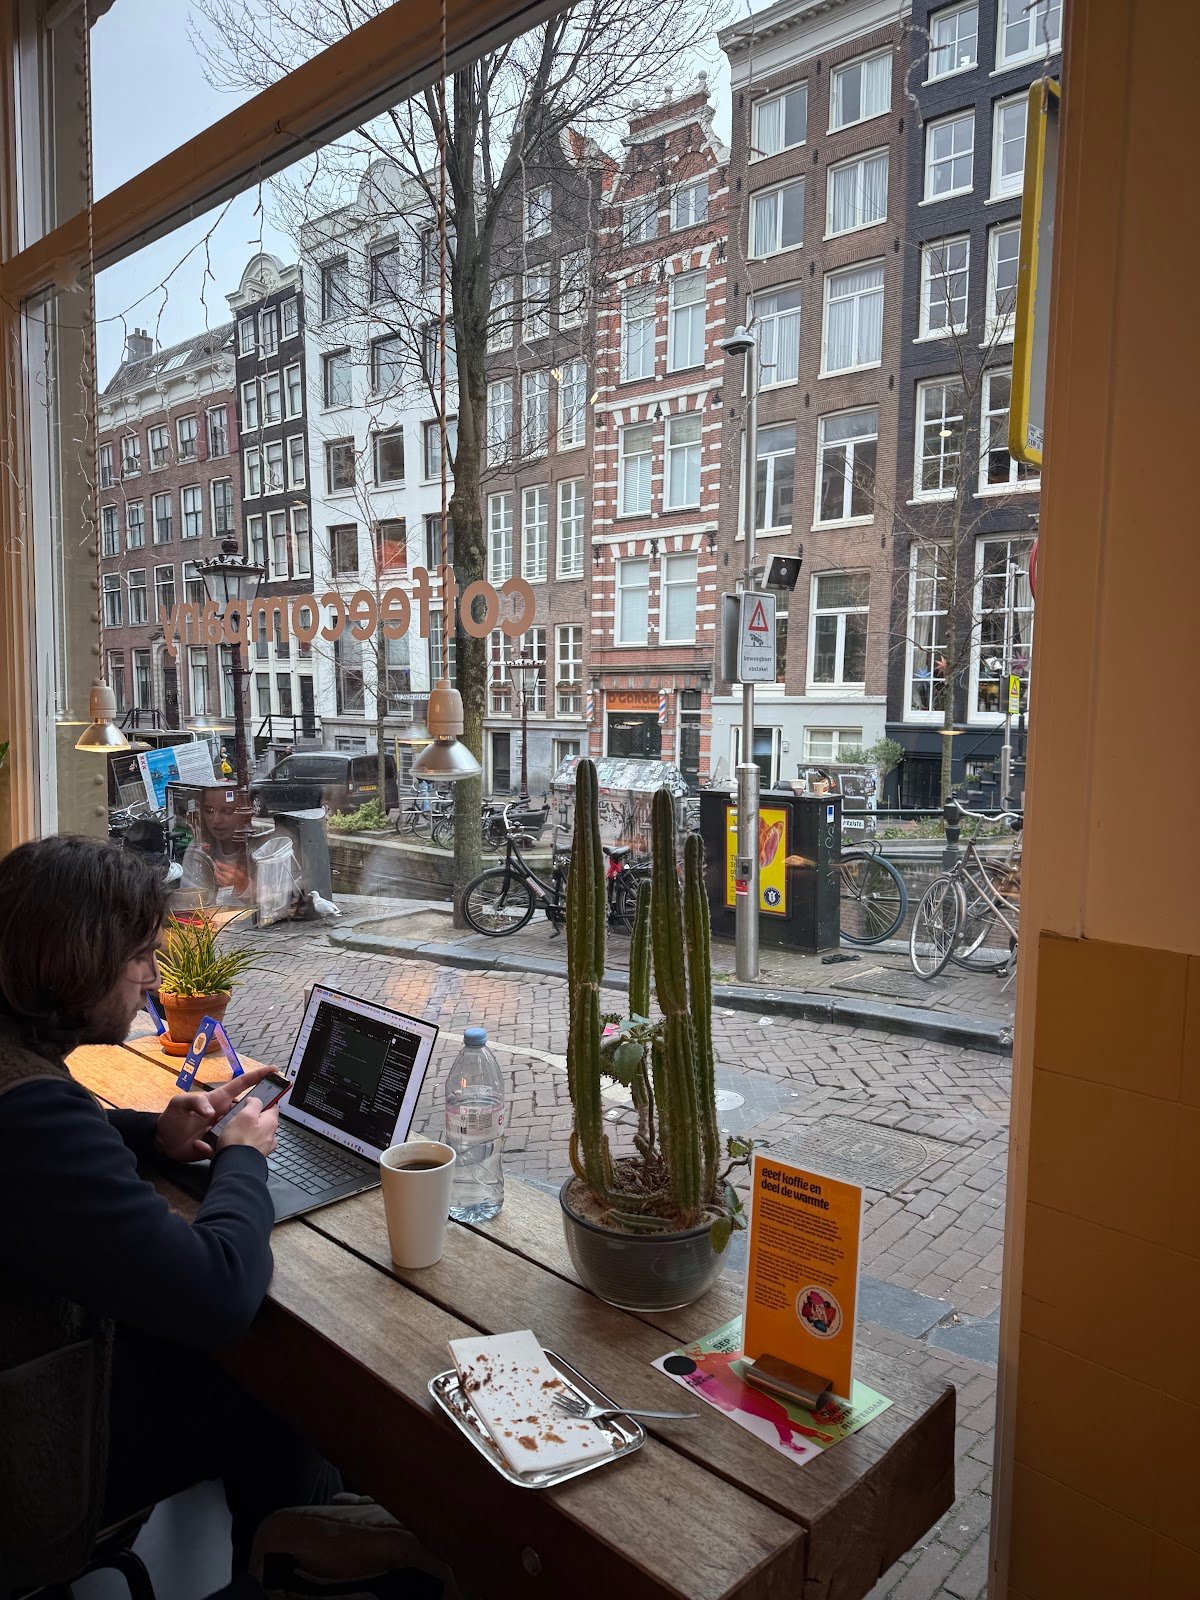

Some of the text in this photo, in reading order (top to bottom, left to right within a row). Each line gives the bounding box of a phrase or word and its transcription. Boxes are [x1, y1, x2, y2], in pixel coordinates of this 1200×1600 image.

[761, 1168, 822, 1195] geef koffie en
[761, 1179, 830, 1210] deel de warmte
[713, 1338, 731, 1350] SEP
[841, 1399, 886, 1430] AMSTERDAM
